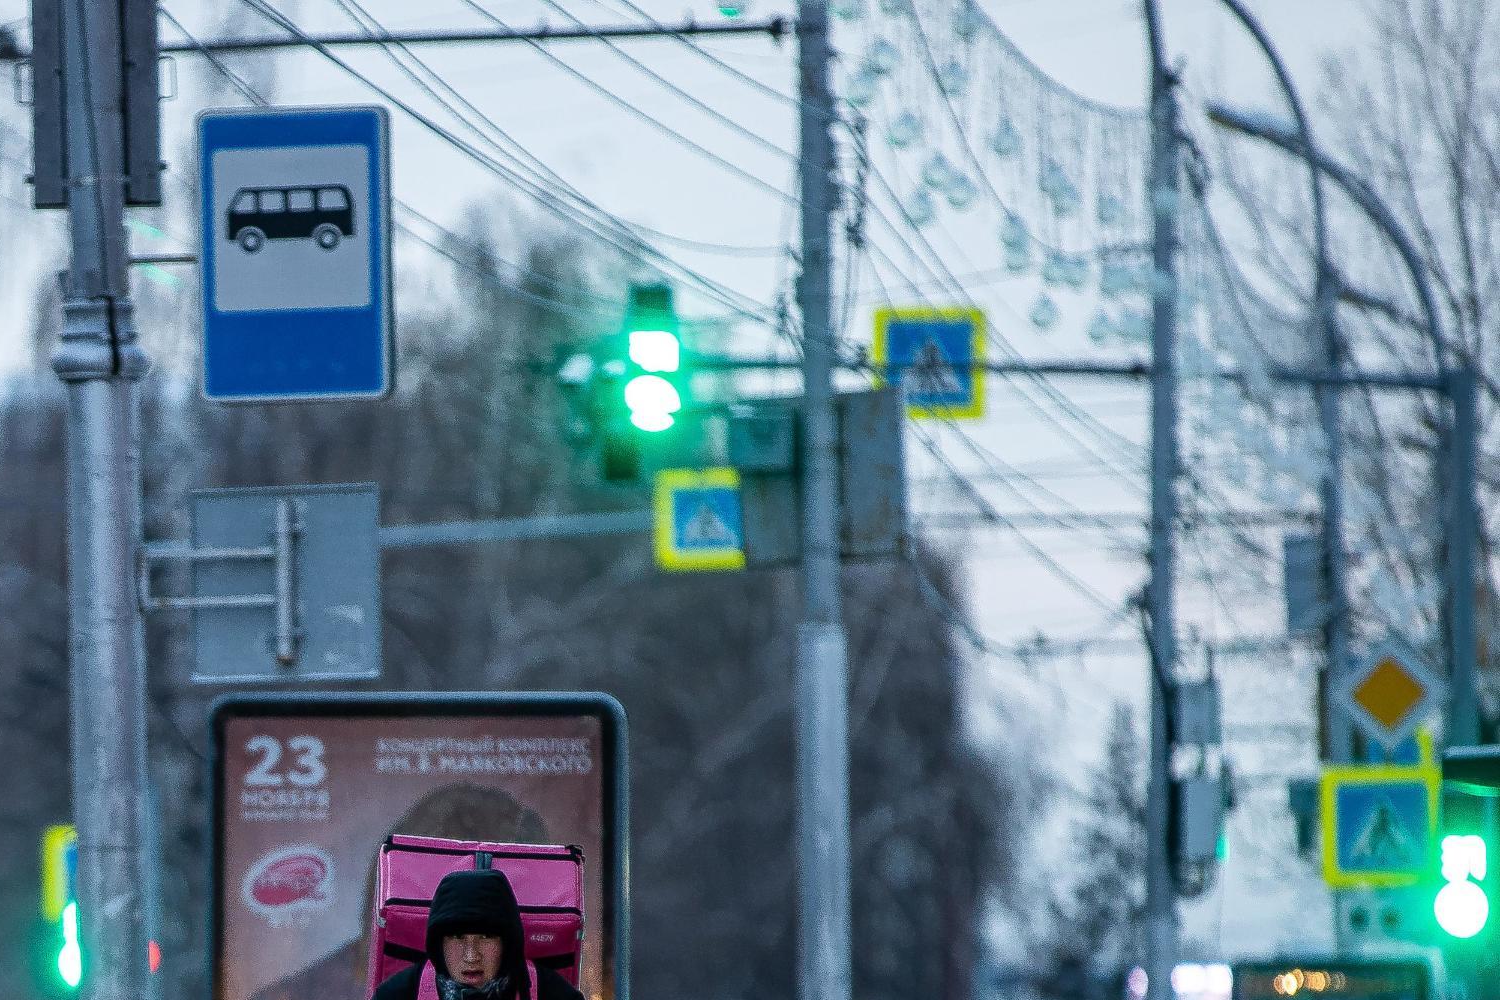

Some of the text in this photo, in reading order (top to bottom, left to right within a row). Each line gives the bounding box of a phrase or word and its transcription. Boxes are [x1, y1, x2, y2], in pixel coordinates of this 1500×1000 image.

[244, 735, 327, 785] 23
[439, 755, 593, 775] МАЯКОВСКОГО
[241, 789, 331, 806] НОЯБРЯ
